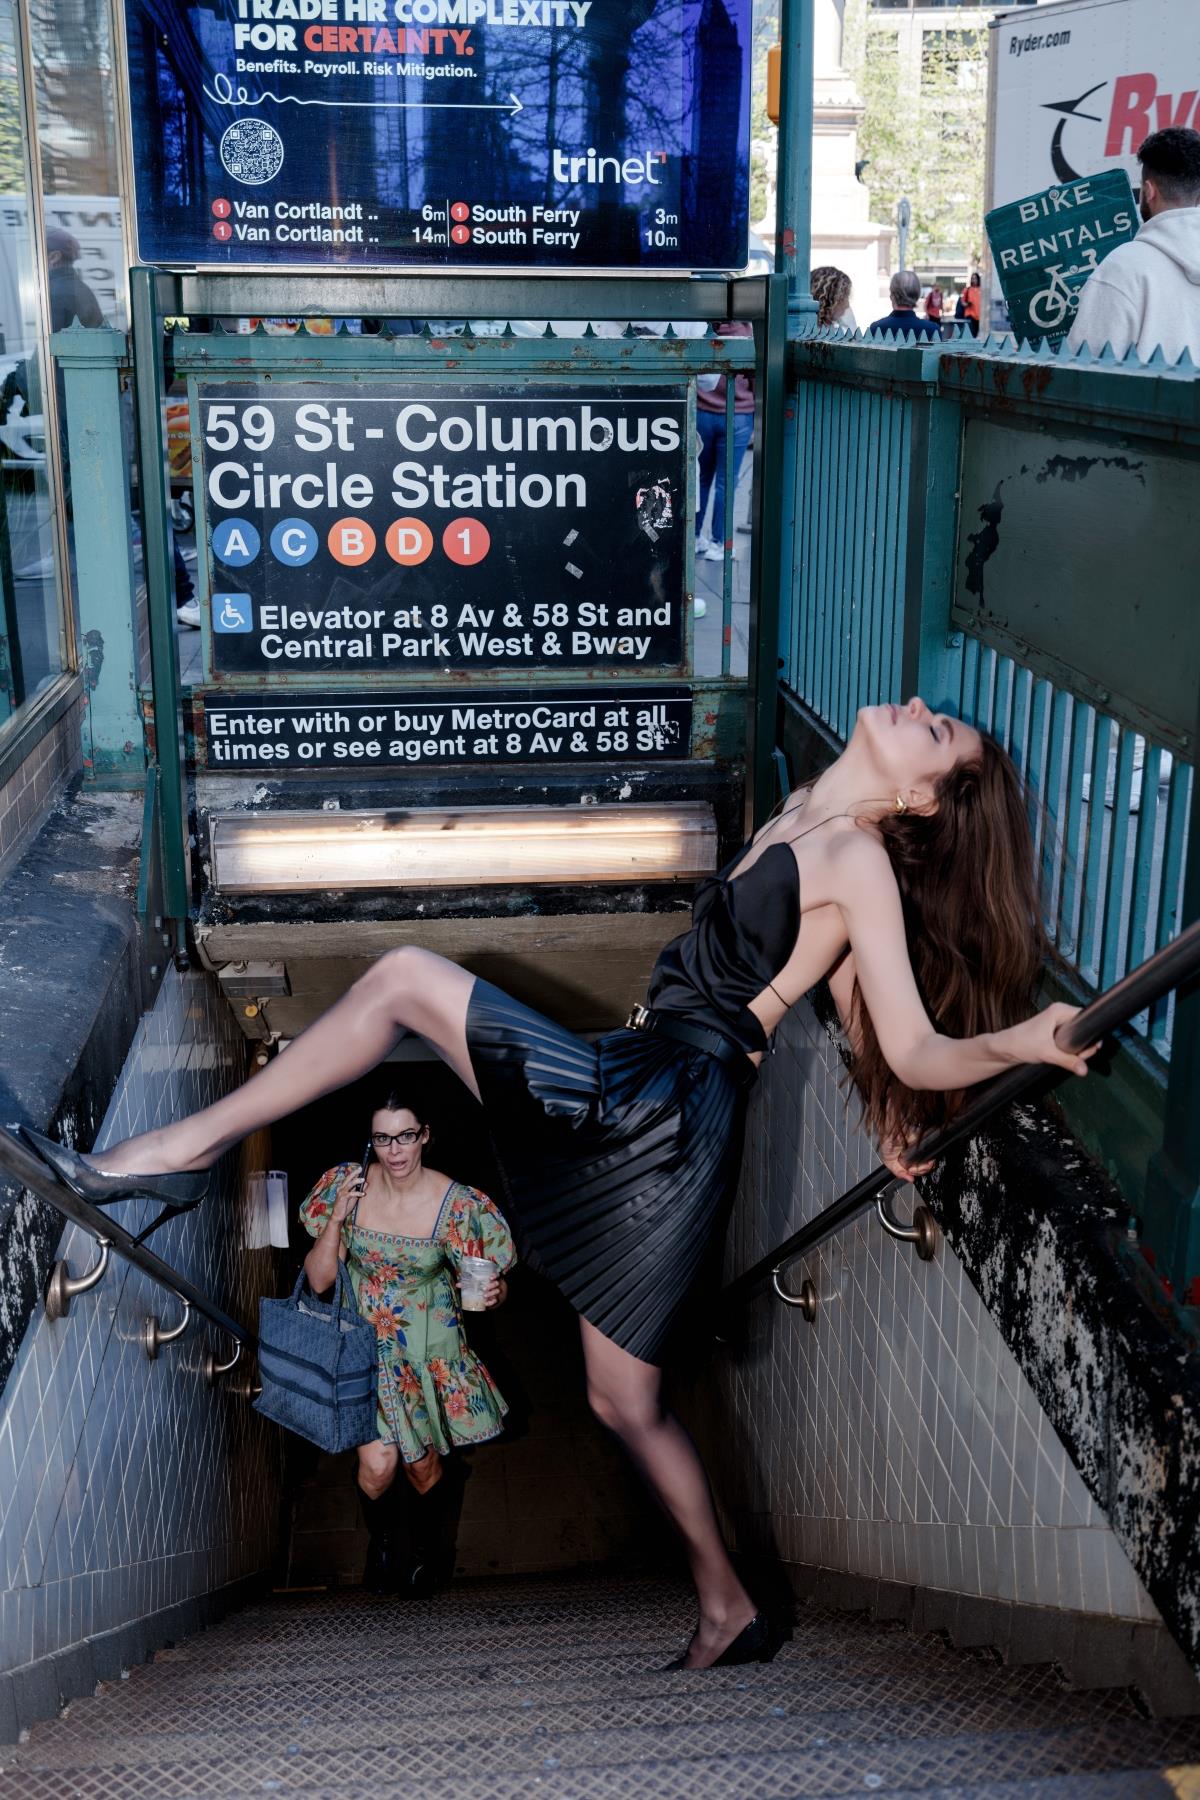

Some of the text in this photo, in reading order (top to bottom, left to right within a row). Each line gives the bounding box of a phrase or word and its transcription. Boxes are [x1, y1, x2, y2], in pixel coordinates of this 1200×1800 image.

[237, 0, 592, 27] TRADE HR COMPLEXITY
[234, 23, 474, 56] FOR CERTAINTY.
[1009, 30, 1071, 57] Ryder.com
[236, 58, 478, 80] Benefits. Payroll. Risk Mitigation.
[1104, 72, 1200, 157] Ry
[553, 147, 662, 184] trinet
[233, 202, 269, 219] Van
[274, 202, 363, 220] Cortlandt
[422, 205, 446, 221] 6m
[472, 205, 527, 222] South
[532, 206, 580, 227] Ferry
[655, 208, 678, 225] 3m
[1018, 181, 1094, 223] BIKE
[234, 224, 270, 241] Van
[275, 224, 364, 242] Cortlandt
[412, 227, 446, 244] 14m
[472, 227, 527, 245] South
[532, 228, 580, 249] Ferry
[645, 230, 678, 247] 10m
[1000, 212, 1132, 269] RENTALS
[205, 405, 275, 452] 59
[295, 404, 354, 452] St
[396, 404, 681, 452] Columbus
[208, 461, 587, 509] Circle Station
[223, 528, 250, 556] A
[281, 529, 307, 557] C
[341, 529, 365, 556] B
[398, 529, 423, 556] D
[259, 602, 671, 630] Elevator at 8 Av & 58 St and
[260, 631, 651, 660] Central Park West & Bway
[210, 705, 667, 736] Enter with or buy MetroCard at all
[212, 729, 665, 761] times or see agent at 8 Av & 58 St
